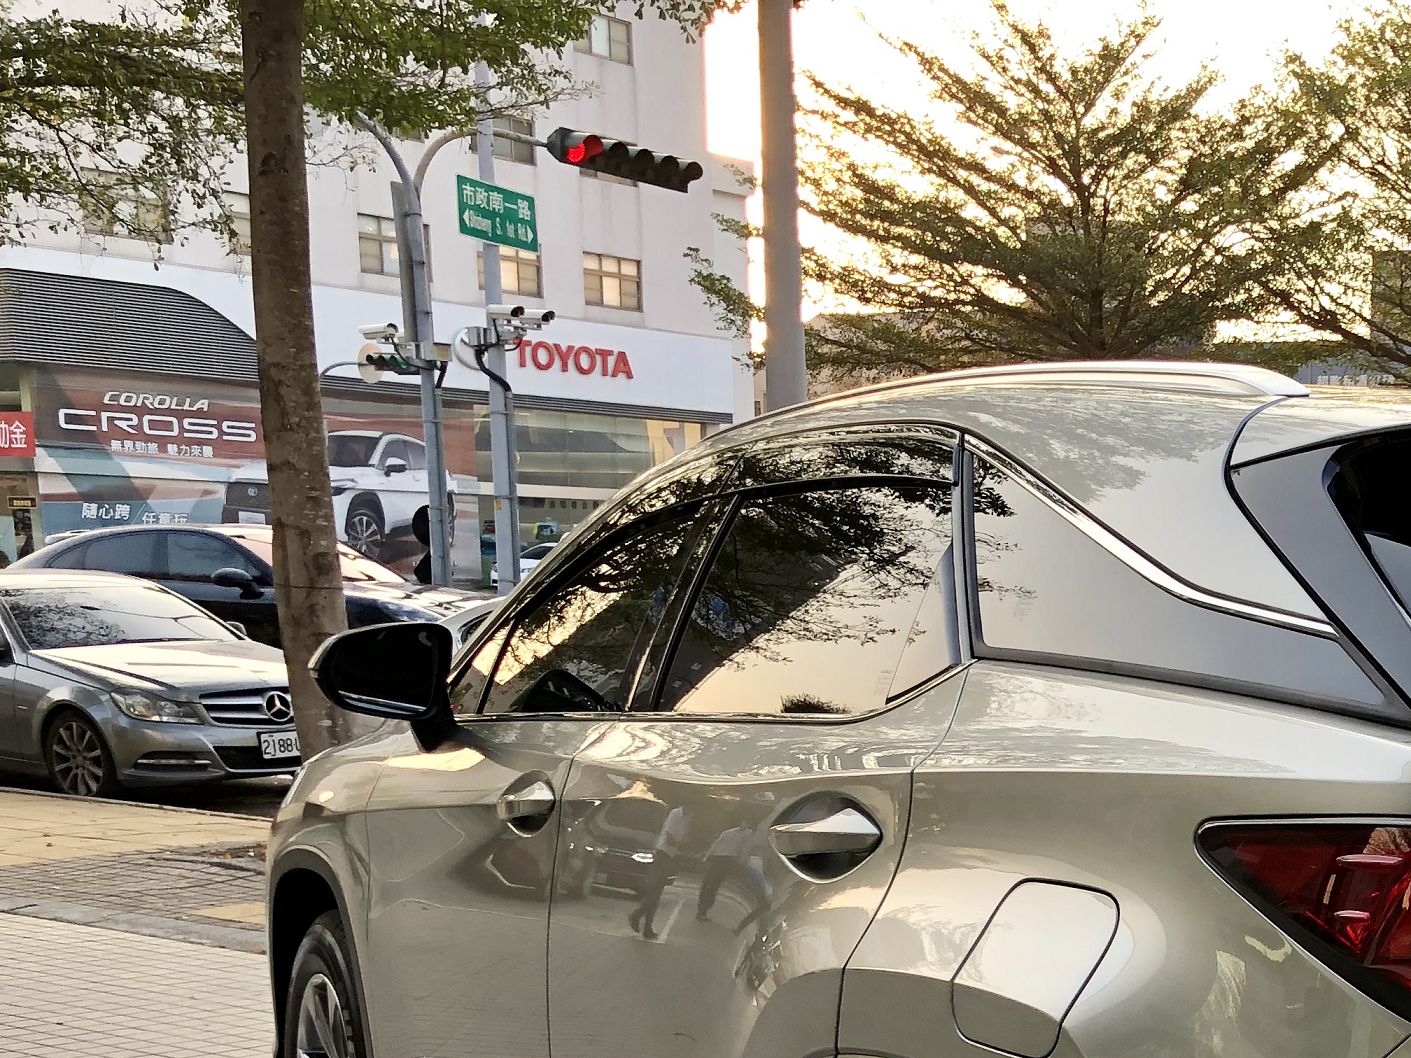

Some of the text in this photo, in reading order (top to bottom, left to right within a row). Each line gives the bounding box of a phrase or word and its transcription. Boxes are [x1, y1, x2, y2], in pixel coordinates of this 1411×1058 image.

[462, 182, 531, 220] 市政南一路
[513, 337, 634, 379] TOYOTA
[103, 391, 209, 412] COROLLA
[58, 408, 257, 442] CROSS
[81, 502, 131, 520] 隨心跨
